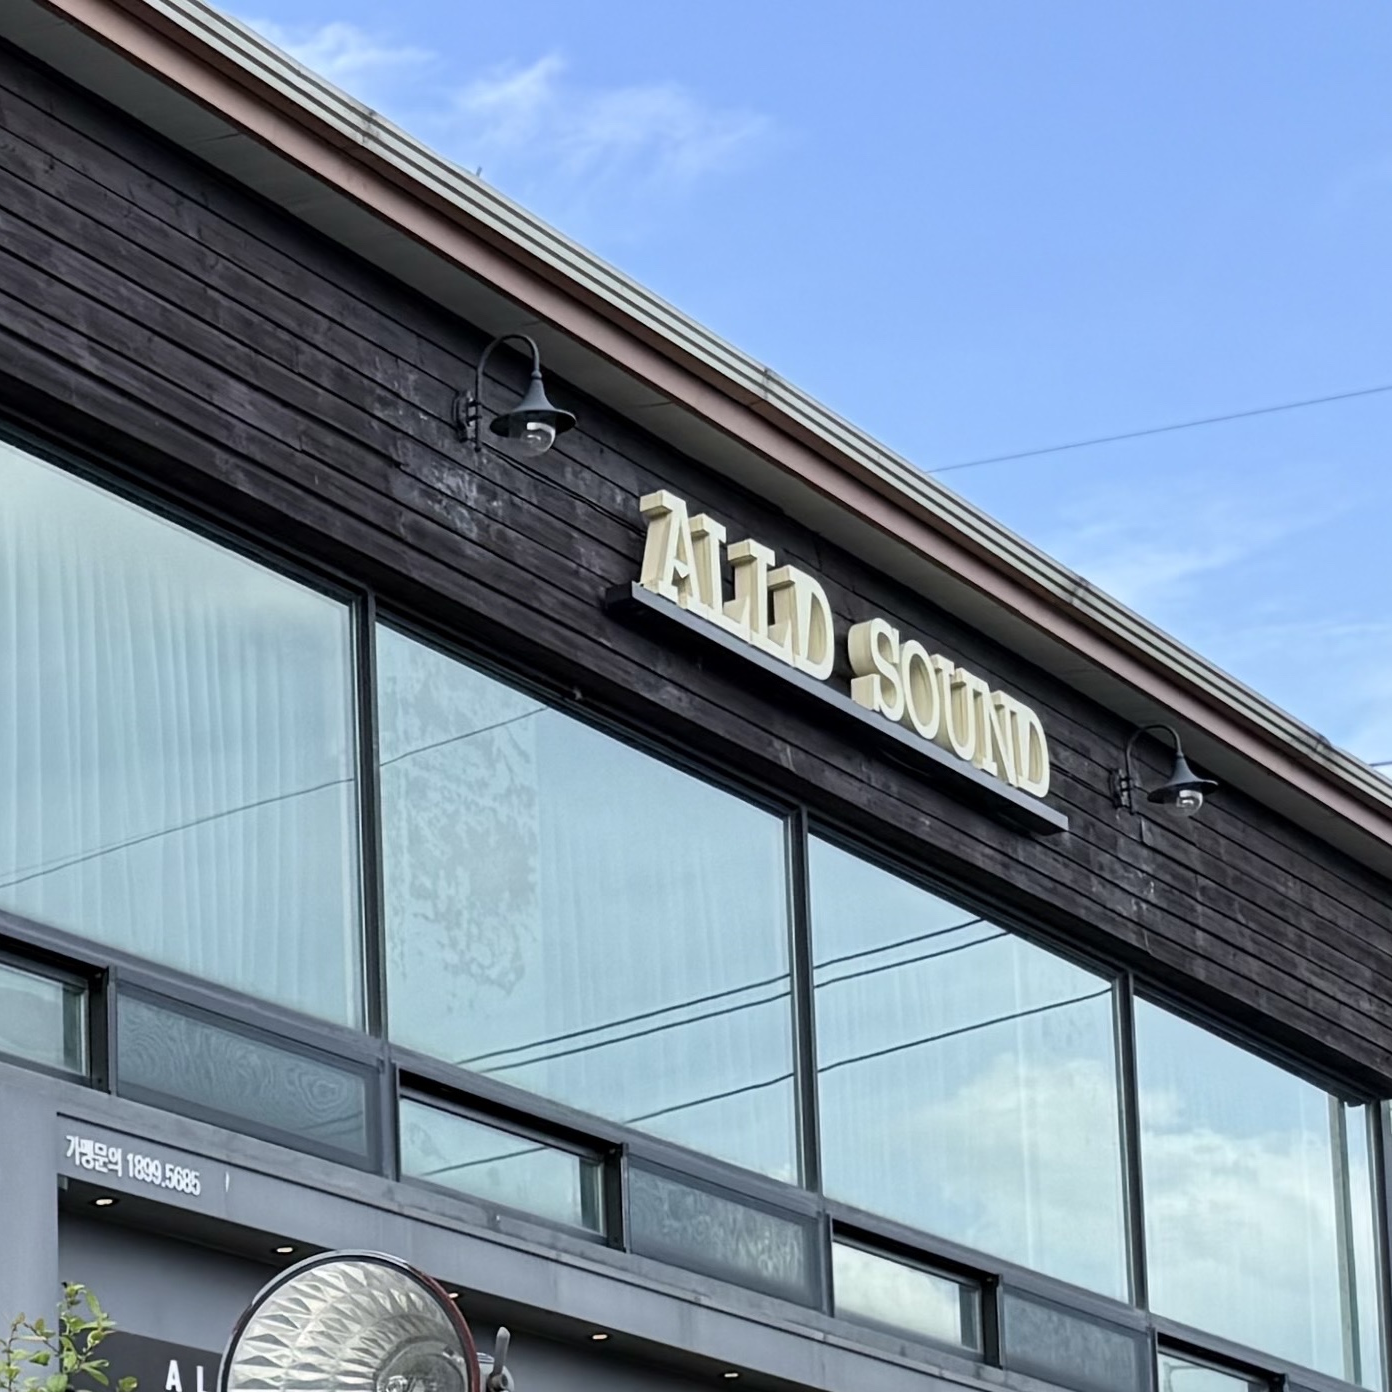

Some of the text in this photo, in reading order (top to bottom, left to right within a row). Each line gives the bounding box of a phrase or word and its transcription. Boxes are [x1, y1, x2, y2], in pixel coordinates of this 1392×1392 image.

[847, 617, 1050, 798] SOUND
[66, 1135, 201, 1196] 가맹문의 1899.5685
